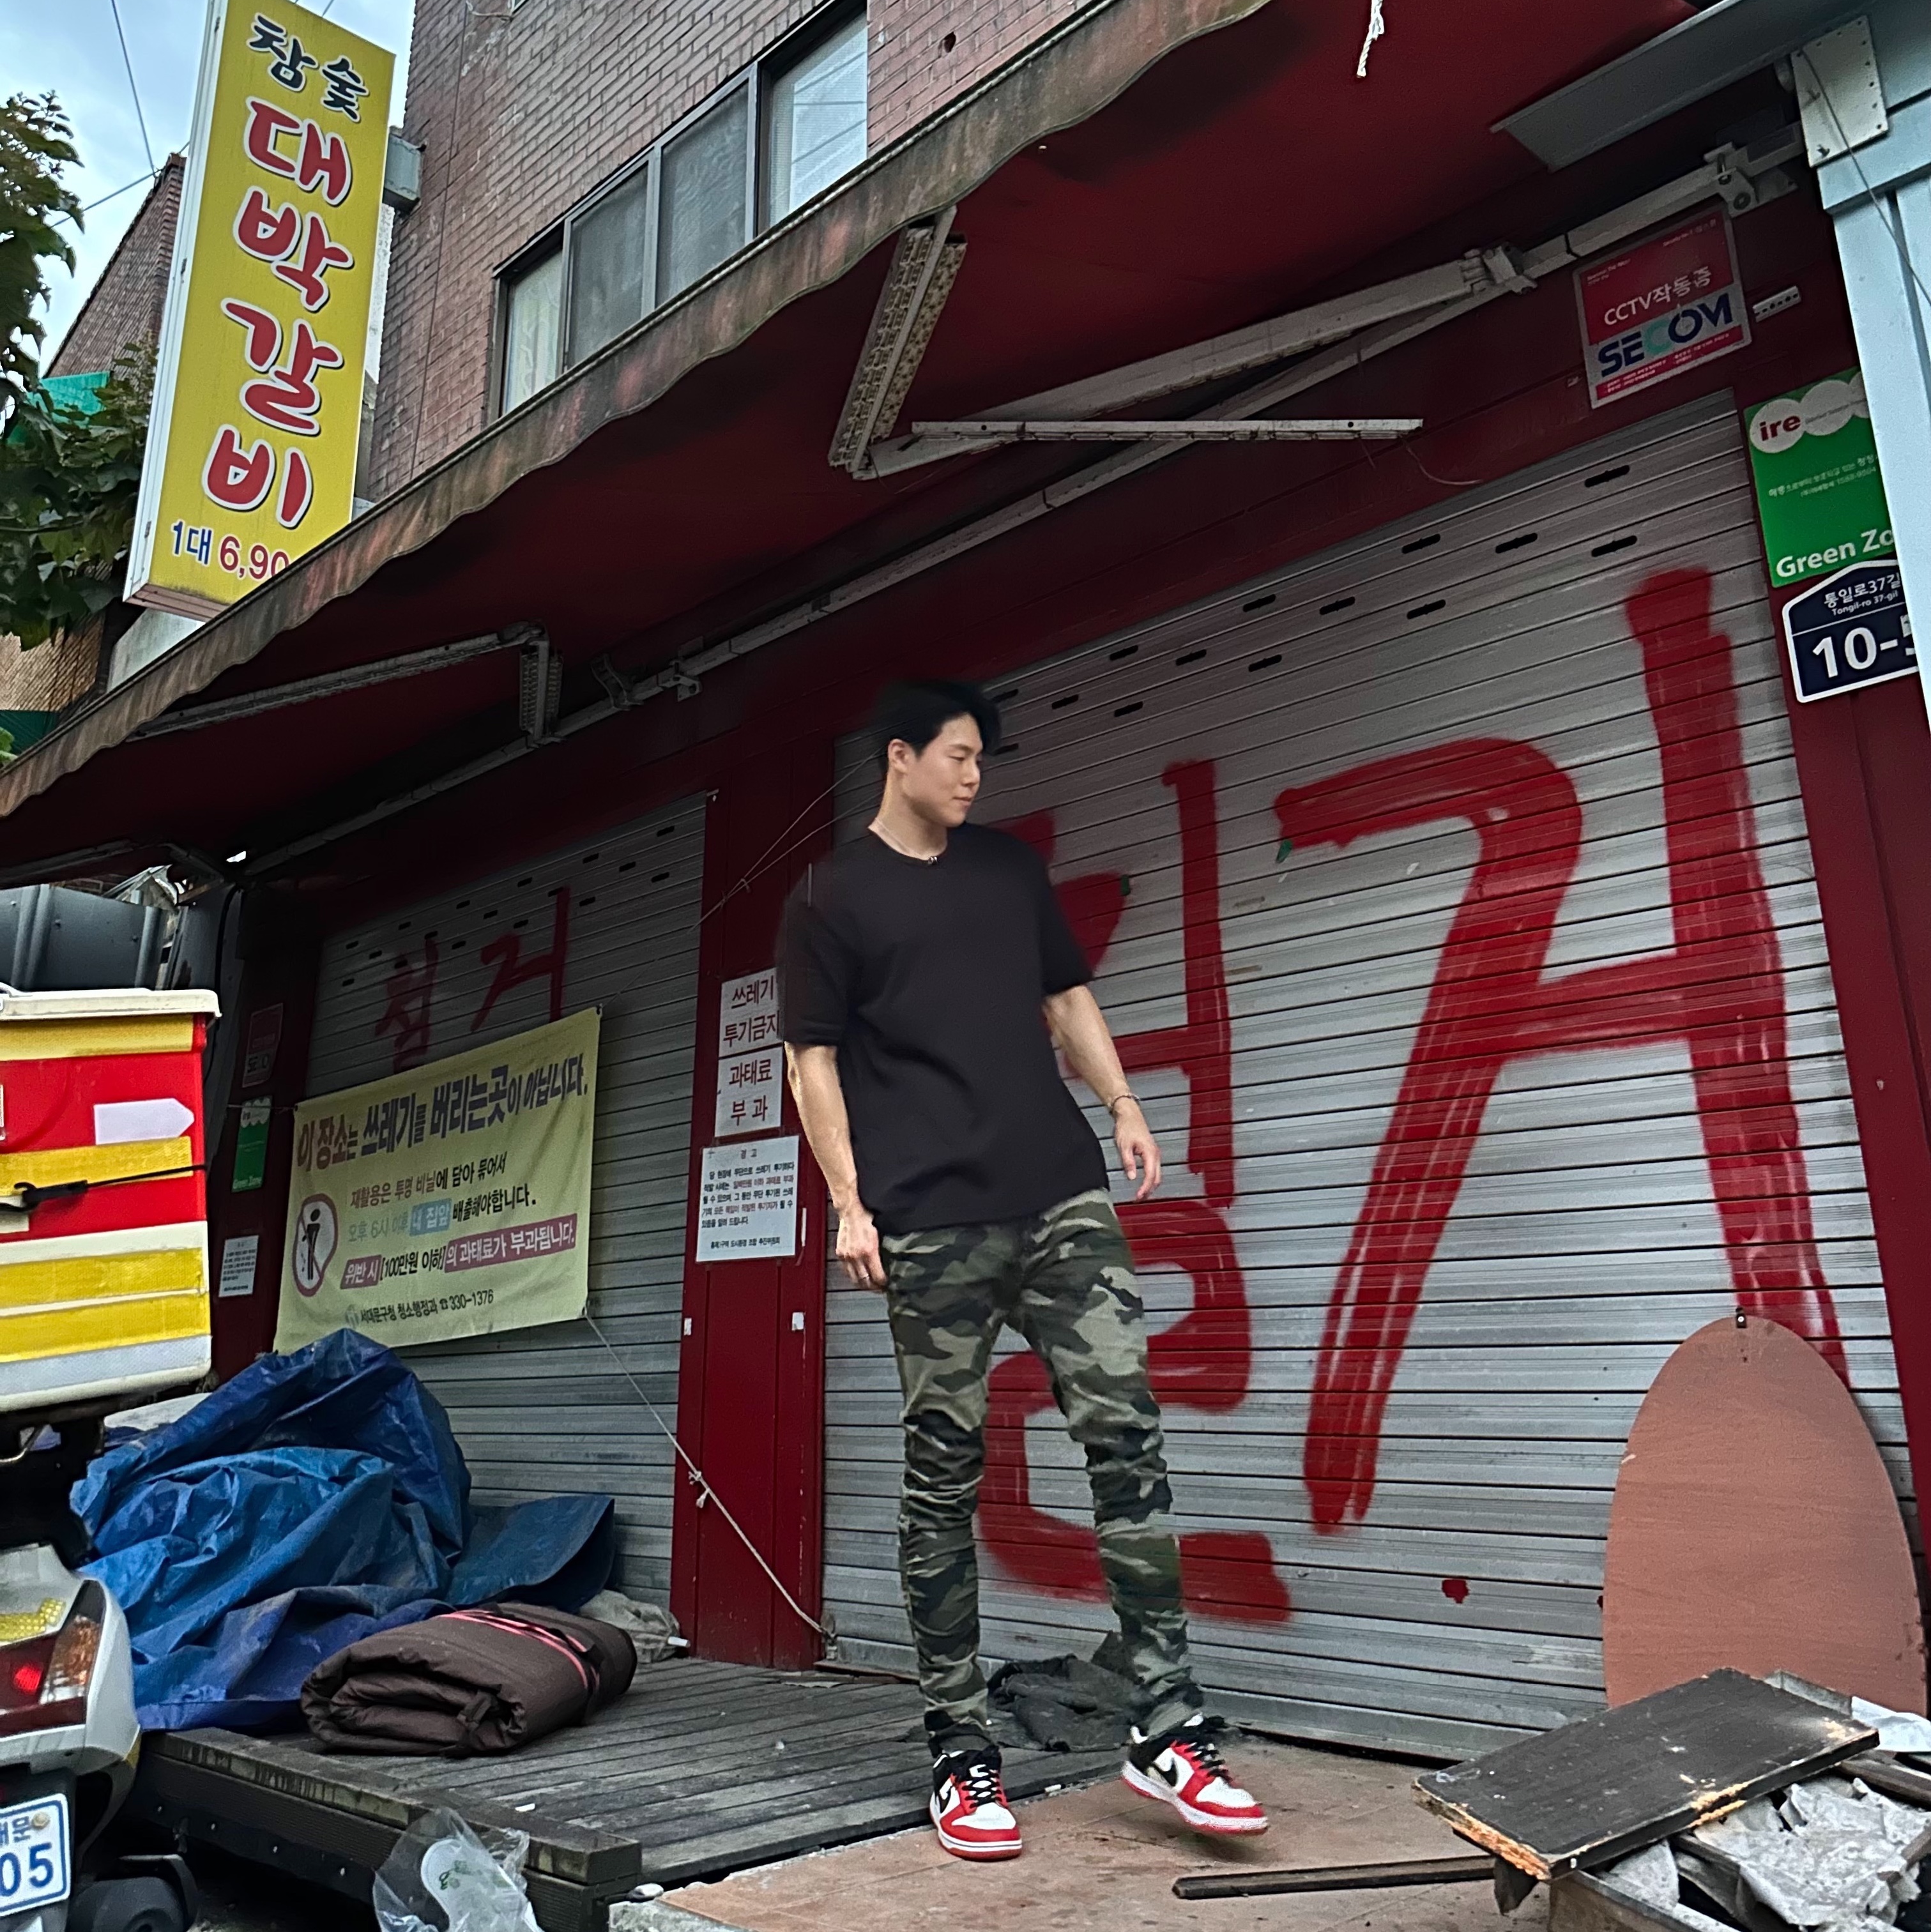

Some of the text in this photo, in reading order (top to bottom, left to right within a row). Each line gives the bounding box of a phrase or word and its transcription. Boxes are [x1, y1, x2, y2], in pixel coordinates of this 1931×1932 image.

[204, 96, 353, 528] 대박갈비
[1604, 266, 1712, 326] CCTV작동중
[1598, 293, 1732, 377] SECOM
[1760, 416, 1801, 441] ire
[173, 521, 212, 565] 1대
[1776, 529, 1895, 577] Green Zo
[1824, 572, 1902, 608] 통일로37길
[1832, 590, 1898, 616] Tongil-ro 37-gil
[731, 975, 774, 1010] 쓰레기
[723, 1009, 781, 1047] 투기금지
[729, 1058, 772, 1088] 과태료
[361, 1092, 427, 1155] 쓰레기를
[350, 1182, 392, 1210] 재활용은
[394, 1176, 413, 1201] 투명
[415, 1169, 448, 1194] 비닐에
[452, 1161, 475, 1187] 담아
[348, 1220, 368, 1242] 오후
[371, 1217, 389, 1238] 6시
[345, 1262, 367, 1284] 위반
[367, 1259, 378, 1282] 시
[459, 1234, 507, 1263] 과태료가
[360, 1289, 494, 1324] 서대문구청 청소행정과 330-1376
[0, 1842, 54, 1896] 05
